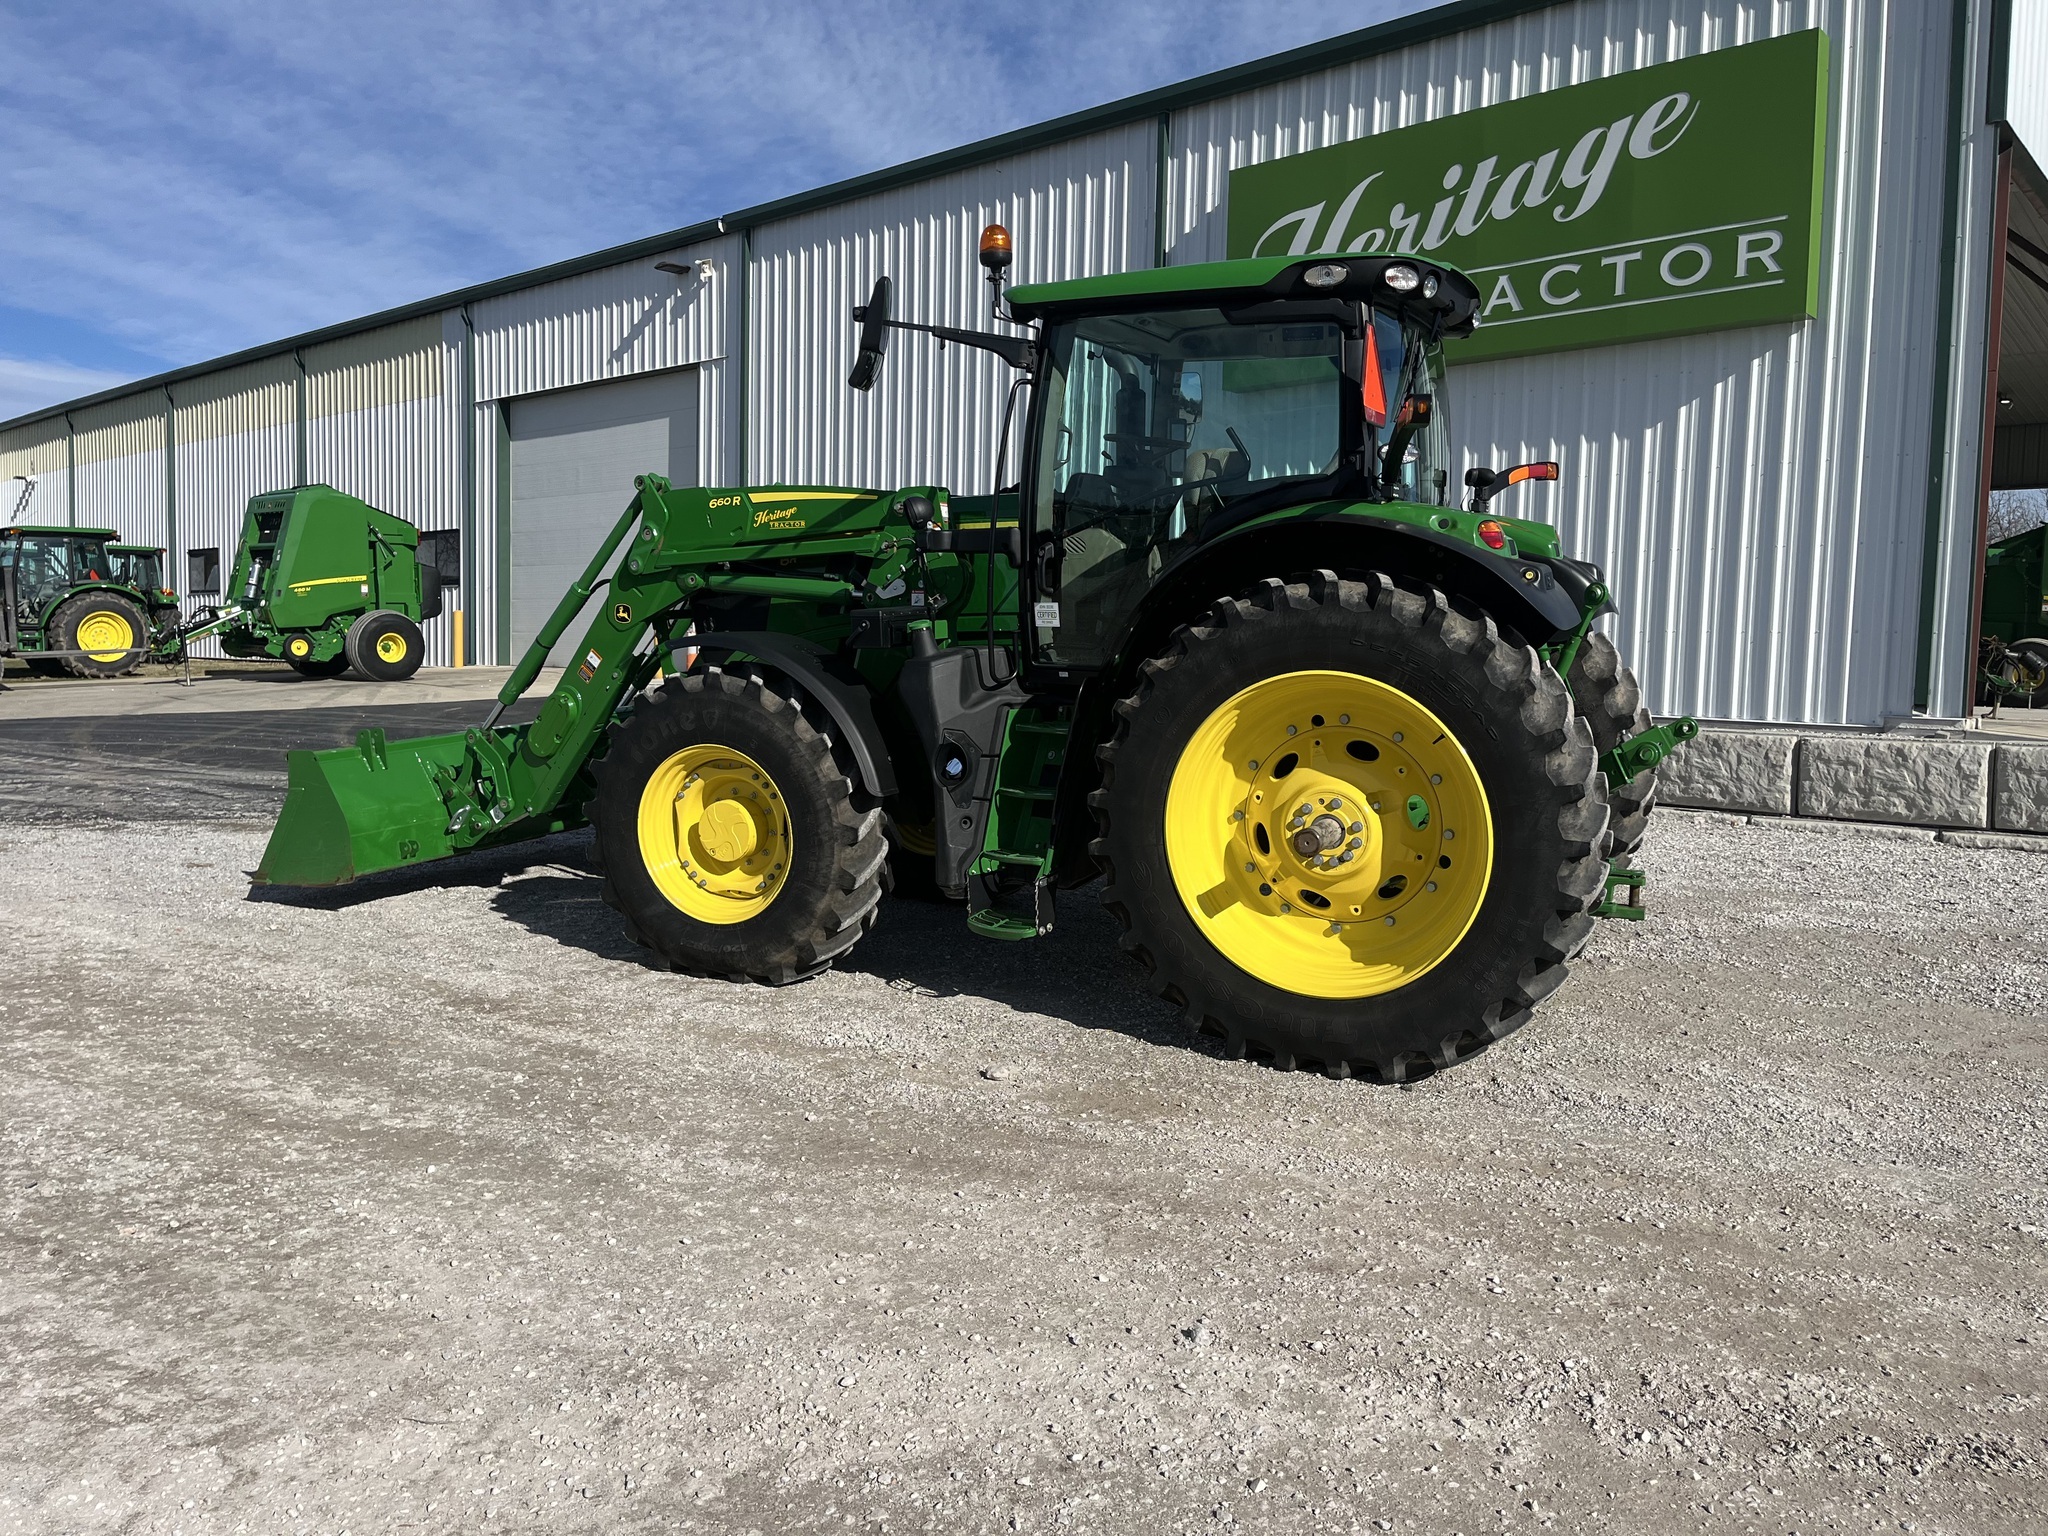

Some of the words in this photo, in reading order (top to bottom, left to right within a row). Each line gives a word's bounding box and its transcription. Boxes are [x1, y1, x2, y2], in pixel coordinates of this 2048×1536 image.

[1251, 91, 1700, 257] Heritage
[1483, 229, 1785, 317] ACTOR
[753, 506, 798, 528] Heritage
[769, 520, 806, 528] TRACTOR
[1130, 860, 1358, 1044] Firestone
